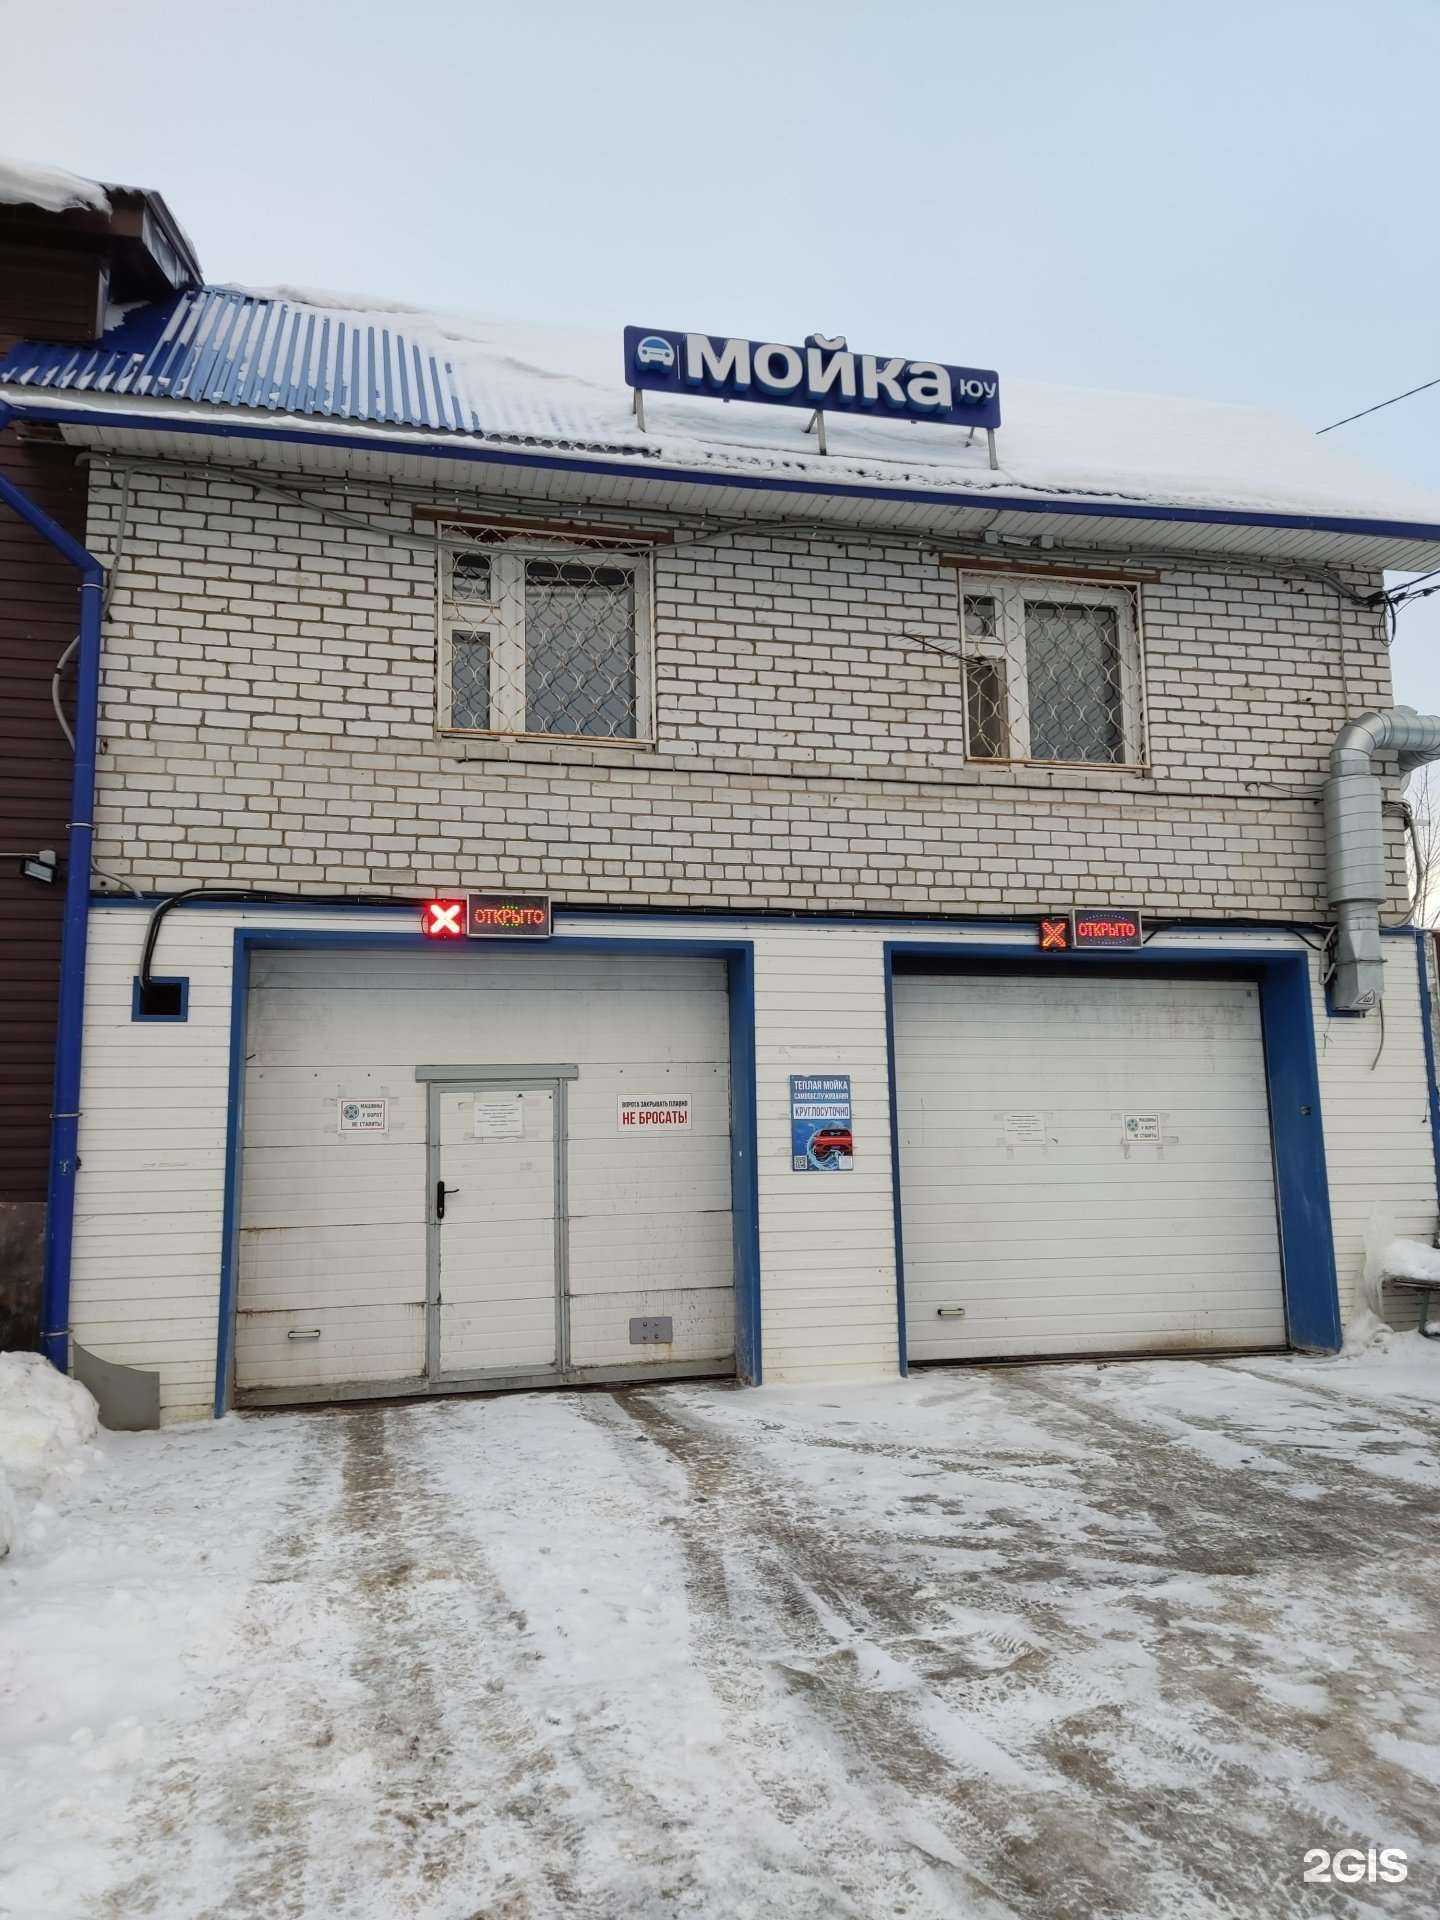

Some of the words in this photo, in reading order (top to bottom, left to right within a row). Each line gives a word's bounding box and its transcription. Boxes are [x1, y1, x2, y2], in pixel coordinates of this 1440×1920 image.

[474, 909, 545, 924] ОТКРЫТО
[1078, 922, 1136, 937] ОТКРЫТО
[794, 1080, 821, 1091] ТЕПЛАЯ
[823, 1080, 848, 1090] МОЙКА
[623, 1111, 636, 1124] НЕ
[639, 1110, 688, 1124] БРОСАТЬ!
[795, 1106, 849, 1117] КРУГЛОСУТОЧНО
